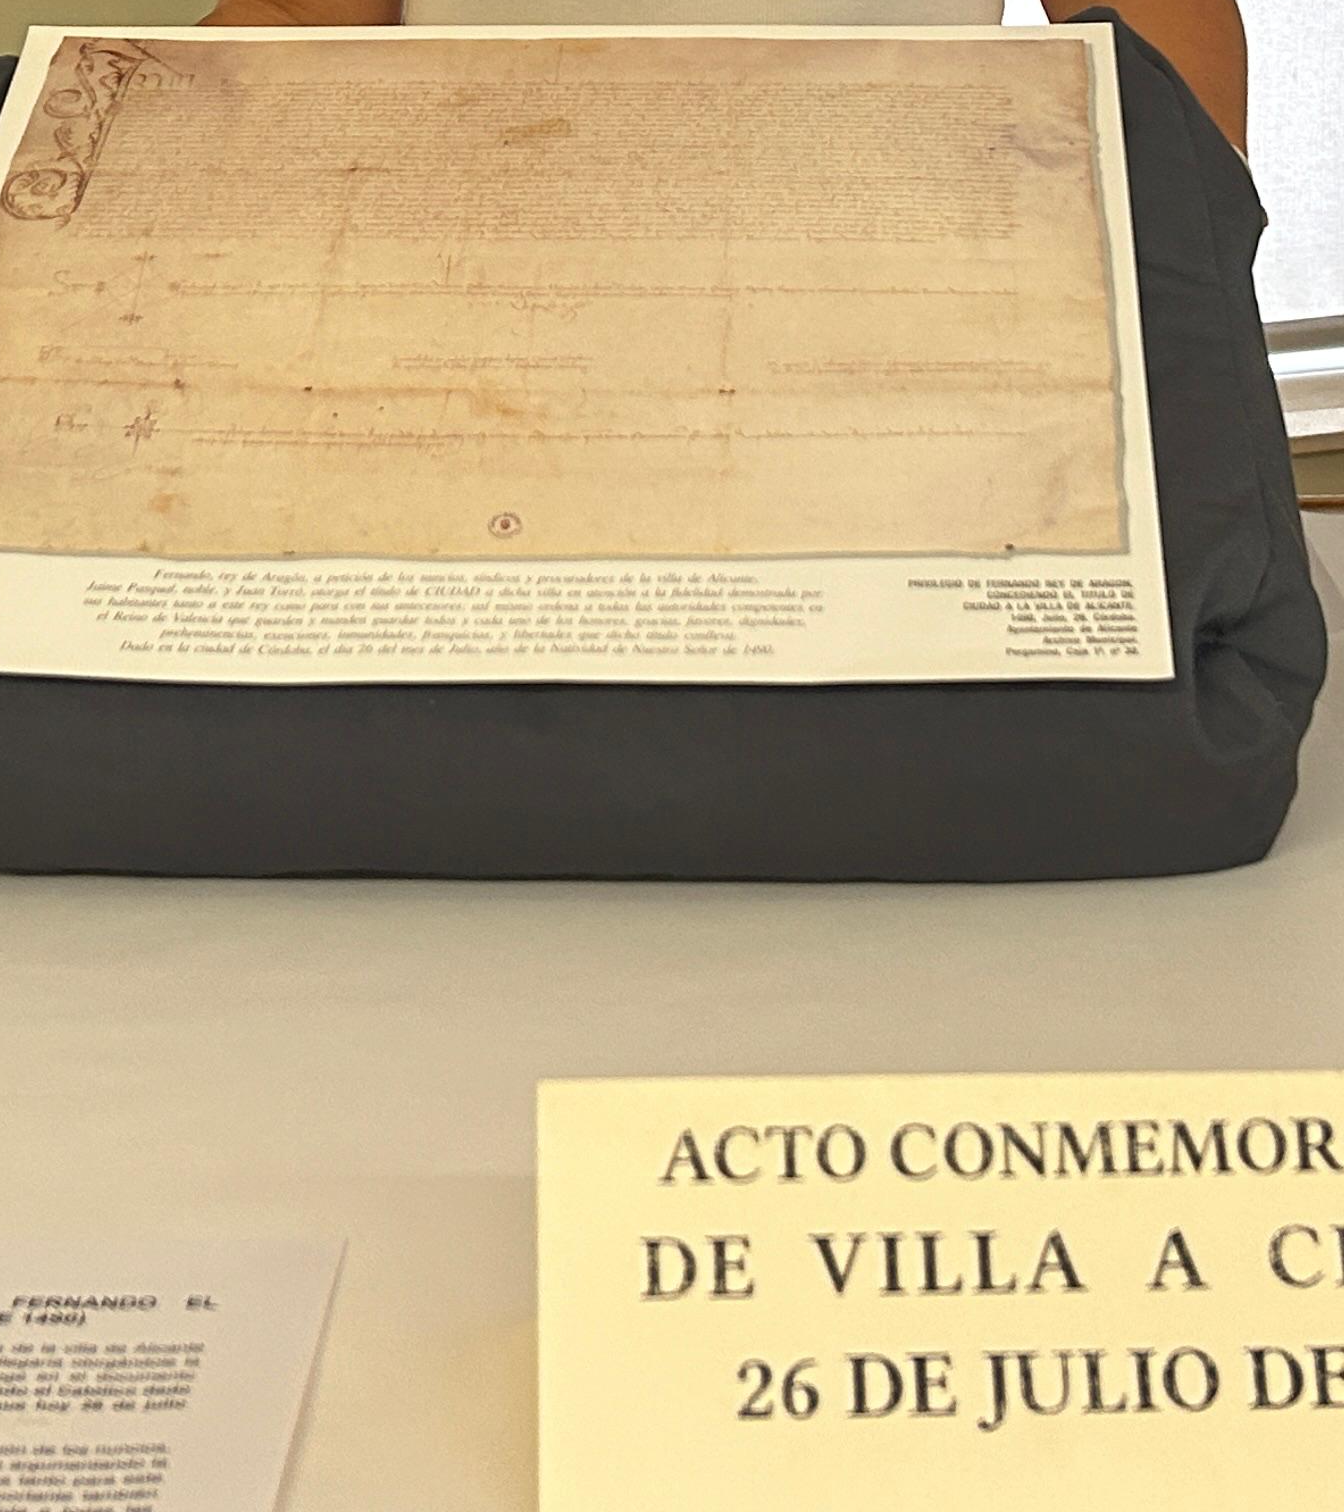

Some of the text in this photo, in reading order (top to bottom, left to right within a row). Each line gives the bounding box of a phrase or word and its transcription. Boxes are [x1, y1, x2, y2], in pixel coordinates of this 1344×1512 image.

[660, 1124, 867, 1185] ACTO
[641, 1235, 755, 1301] DE
[810, 1231, 1086, 1296] VILLA
[1148, 1228, 1208, 1291] A
[11, 1295, 157, 1312] FERNANDO
[186, 1296, 217, 1310] EL
[737, 1358, 820, 1421] 26
[849, 1352, 957, 1418] DE
[978, 1347, 1220, 1432] JULIO
